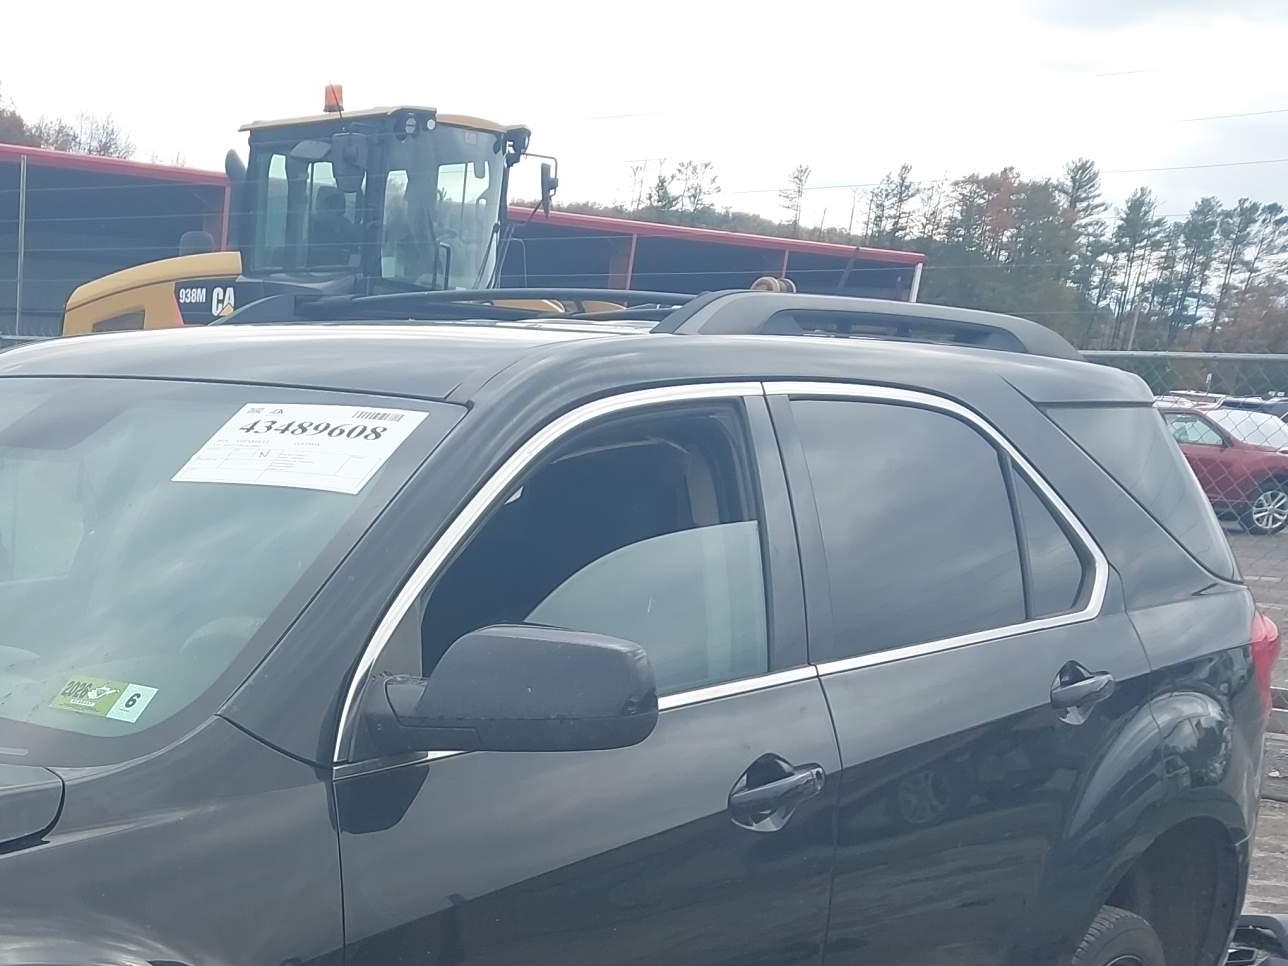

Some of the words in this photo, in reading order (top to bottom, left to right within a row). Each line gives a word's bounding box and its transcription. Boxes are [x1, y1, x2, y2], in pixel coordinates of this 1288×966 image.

[179, 288, 206, 303] 938M
[212, 287, 235, 316] CA
[240, 419, 387, 441] 43489608
[125, 693, 141, 708] 6
